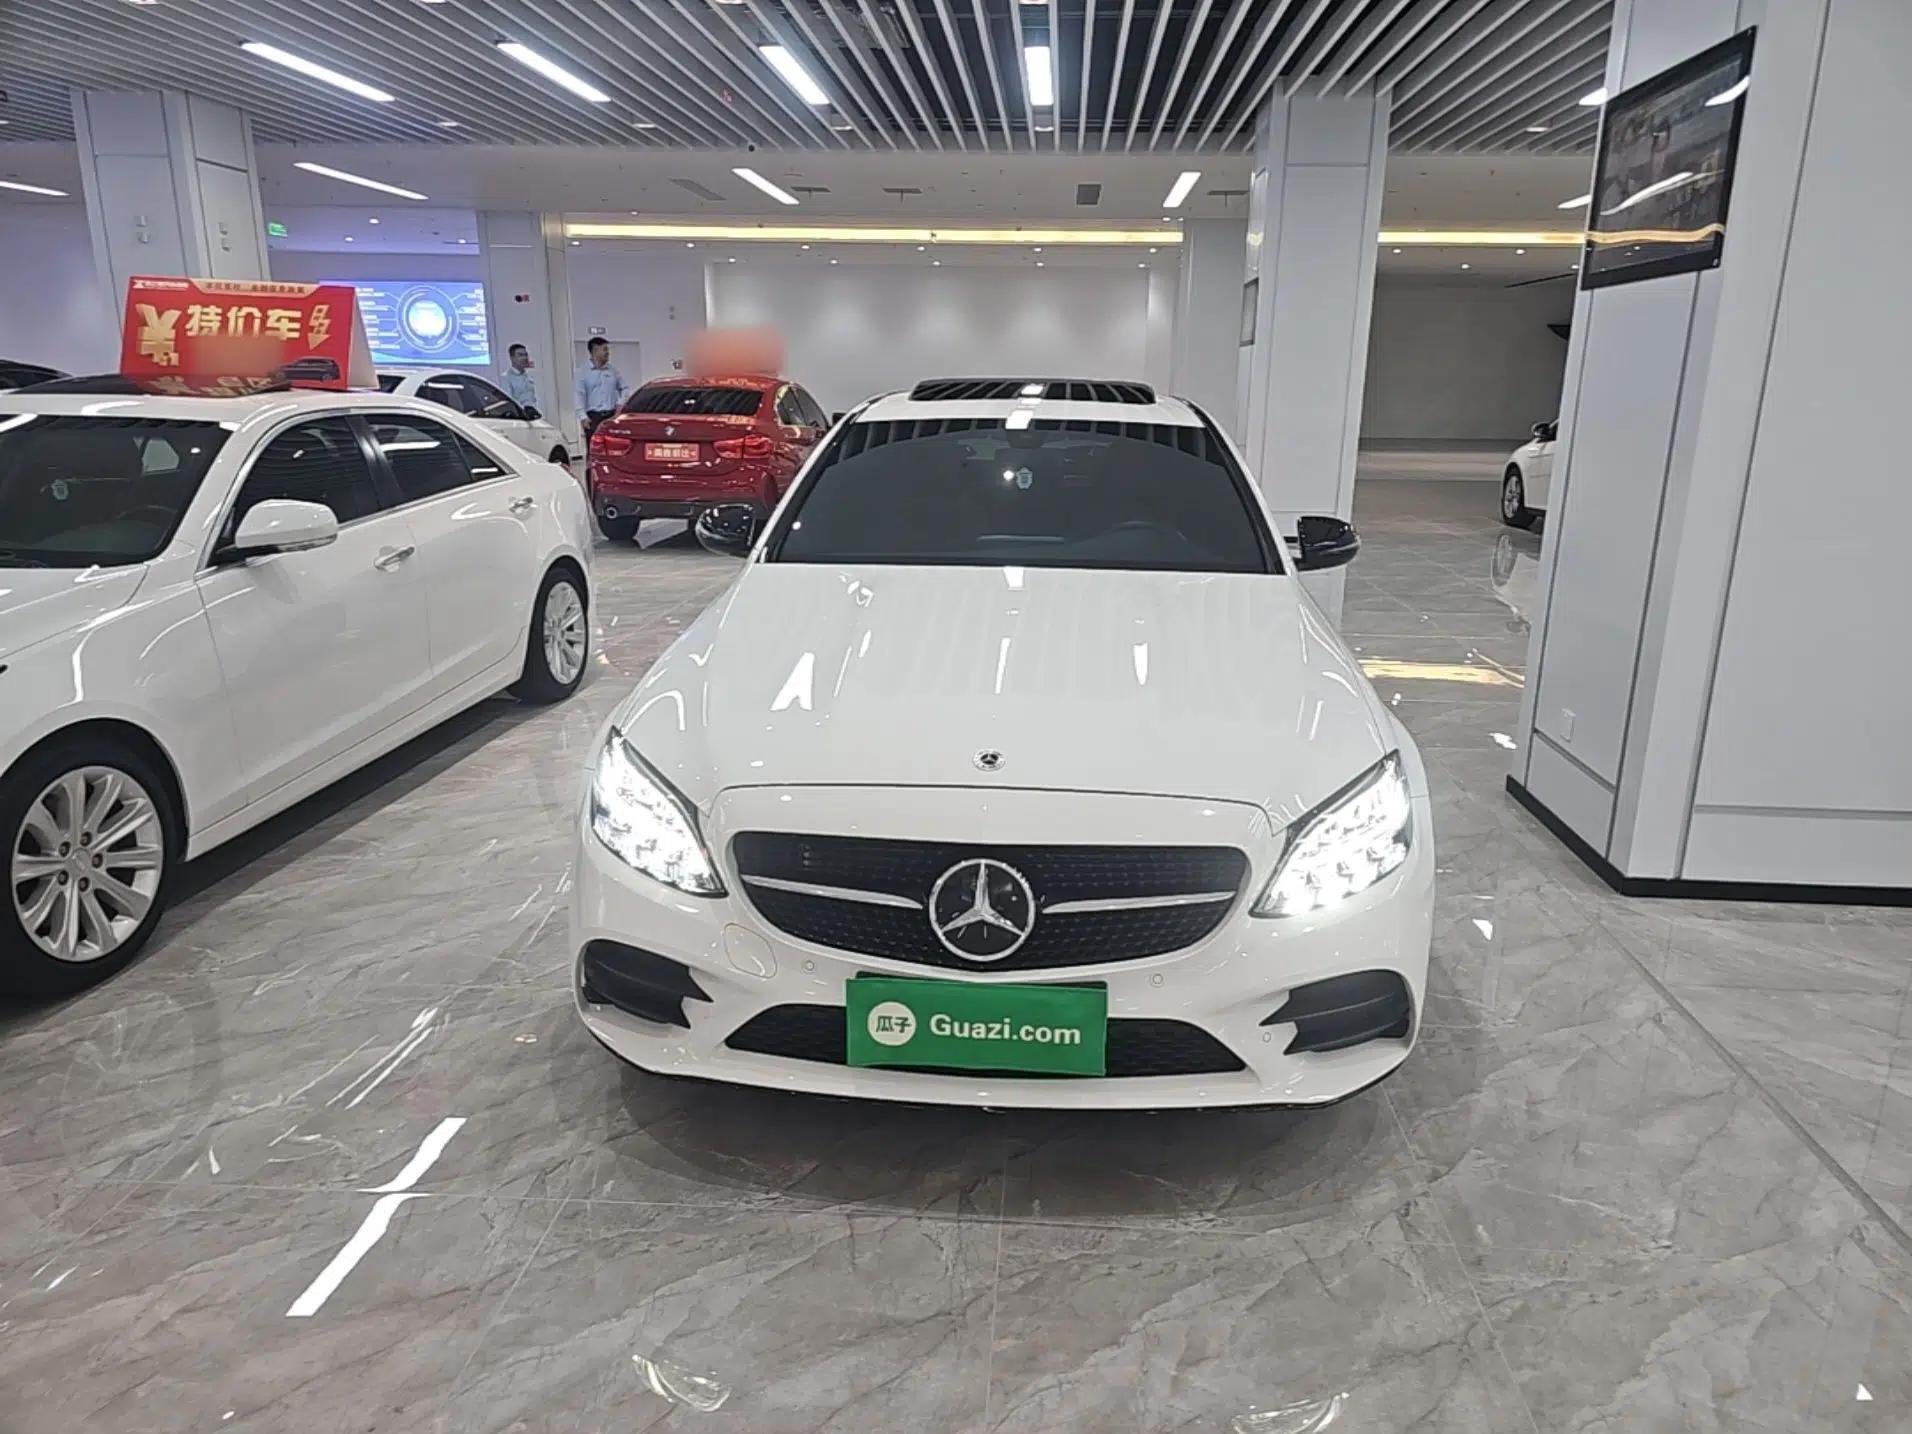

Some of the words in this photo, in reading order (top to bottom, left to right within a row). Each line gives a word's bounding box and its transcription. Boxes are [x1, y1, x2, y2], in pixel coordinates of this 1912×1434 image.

[184, 304, 301, 340] 特价车
[875, 1015, 912, 1034] 瓜子
[929, 1014, 1081, 1045] Guazi.com
